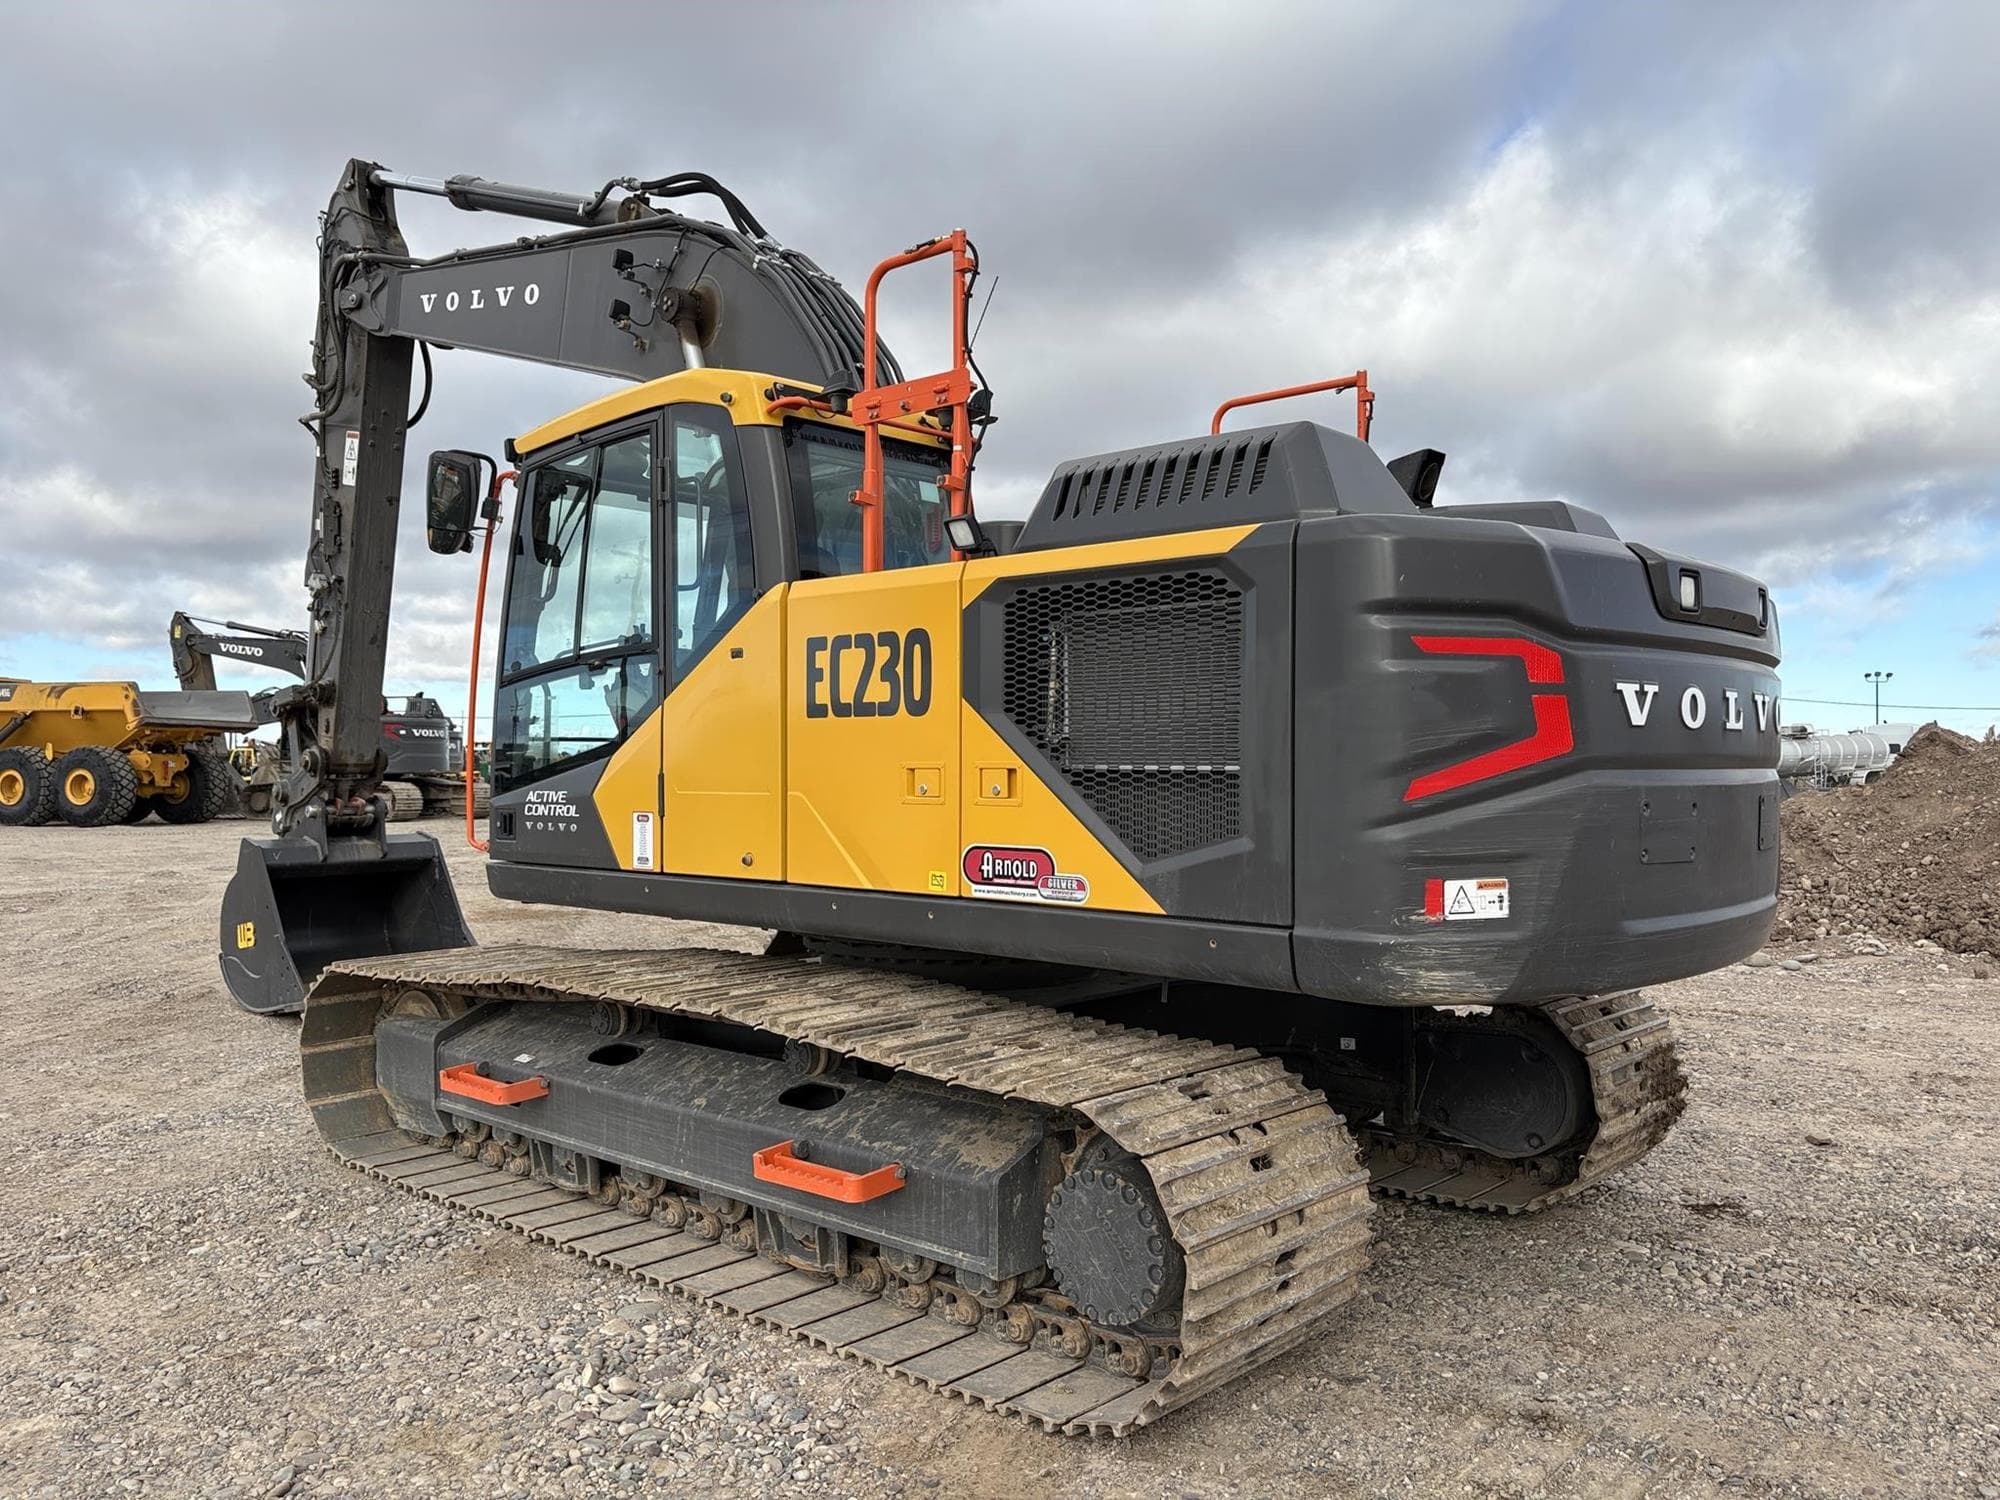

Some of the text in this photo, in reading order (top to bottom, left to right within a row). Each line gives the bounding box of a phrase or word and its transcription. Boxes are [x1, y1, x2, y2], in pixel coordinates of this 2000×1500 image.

[420, 283, 541, 313] VOLVO
[218, 642, 264, 657] VOLVO
[806, 628, 932, 719] EC230
[411, 728, 445, 738] VOLVO
[525, 790, 568, 803] ACTIVE
[524, 804, 580, 817] CONTROL
[525, 821, 578, 833] VOLVO
[980, 851, 1038, 879] ARNOLD
[1047, 878, 1079, 890] SILVER
